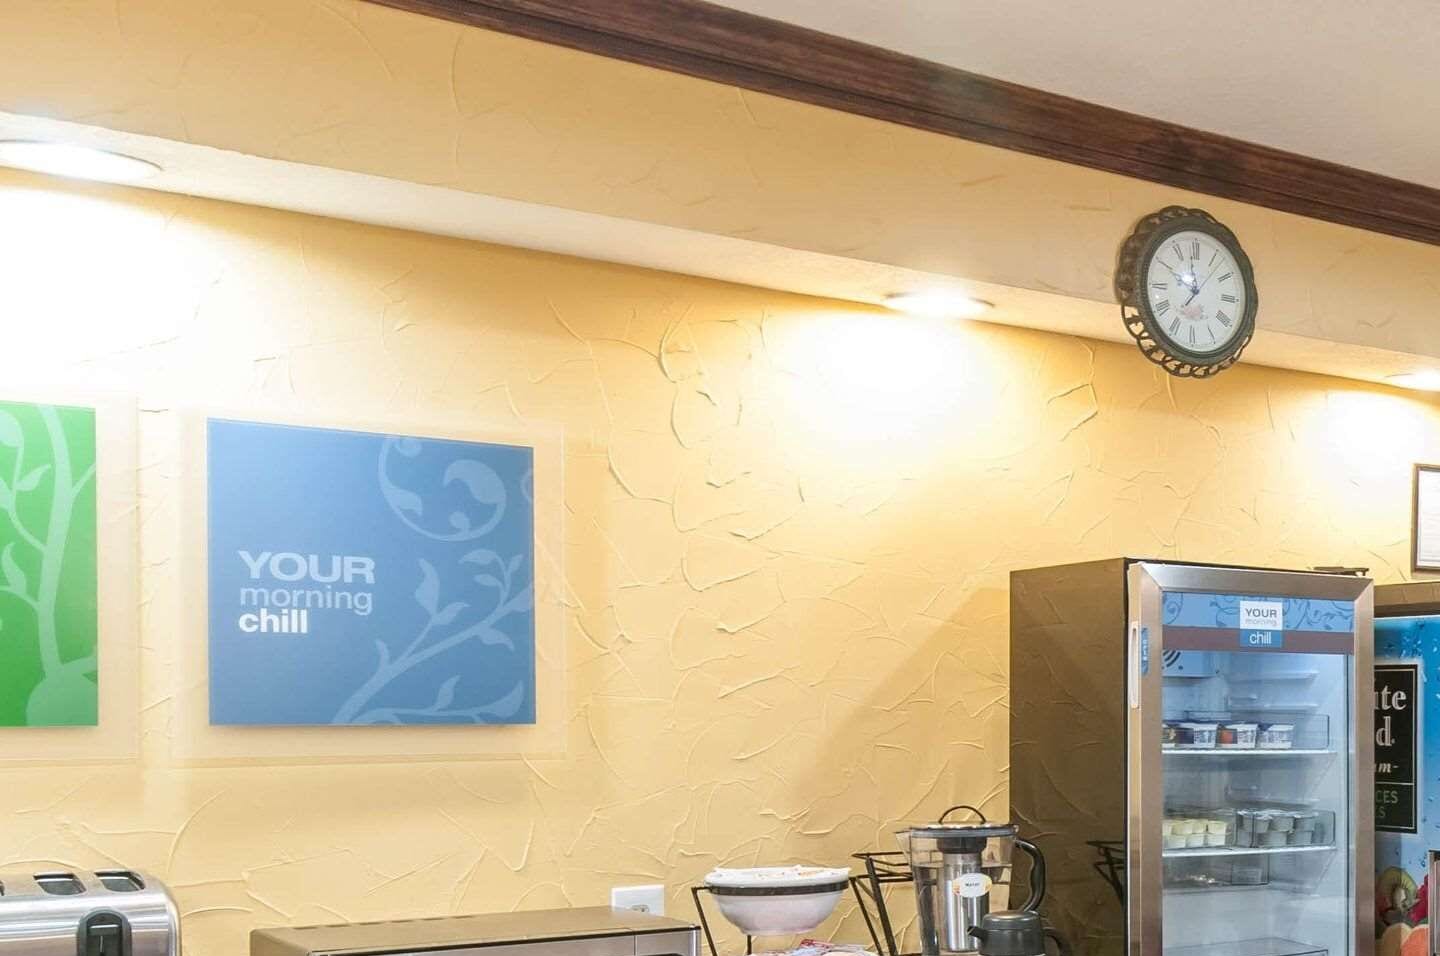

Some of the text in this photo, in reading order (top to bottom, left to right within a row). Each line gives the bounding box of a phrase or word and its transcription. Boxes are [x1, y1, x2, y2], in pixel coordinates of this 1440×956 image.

[238, 550, 376, 584] YOUR
[239, 585, 373, 616] morning
[1244, 607, 1278, 618] YOUR
[238, 607, 308, 634] chill
[1249, 631, 1272, 644] chill
